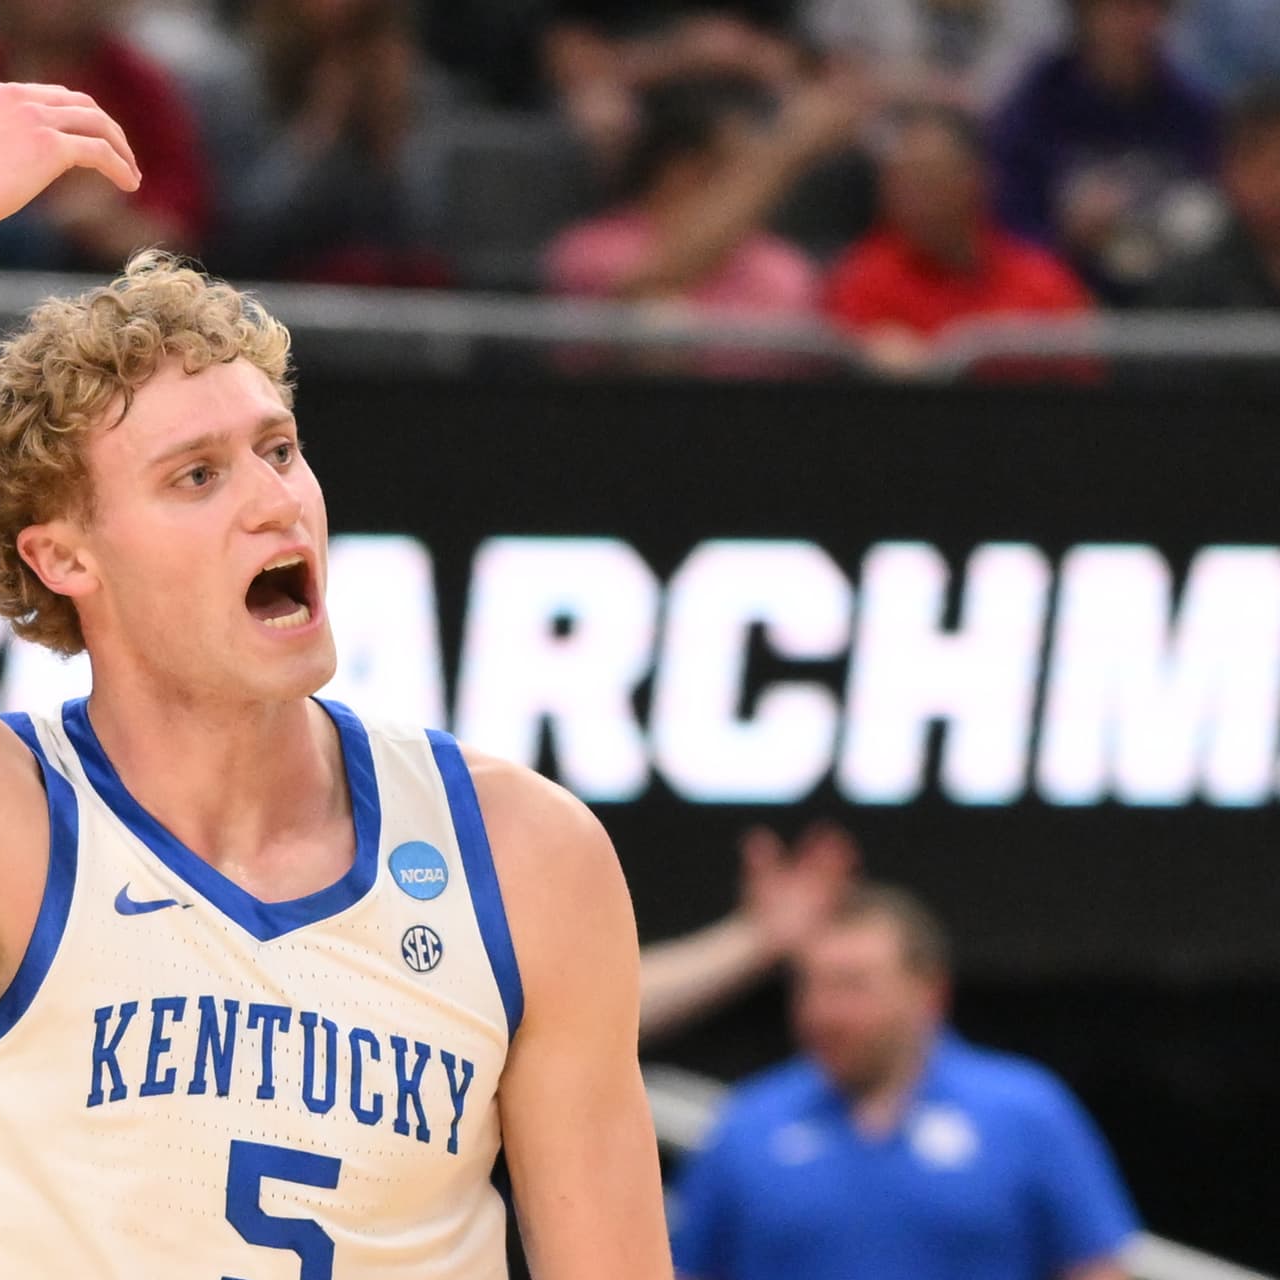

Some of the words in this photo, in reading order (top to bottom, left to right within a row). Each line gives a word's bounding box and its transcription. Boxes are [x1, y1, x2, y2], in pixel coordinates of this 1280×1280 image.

[399, 867, 445, 884] NCAA
[403, 927, 442, 971] SEC
[86, 995, 475, 1156] KENTUCKY
